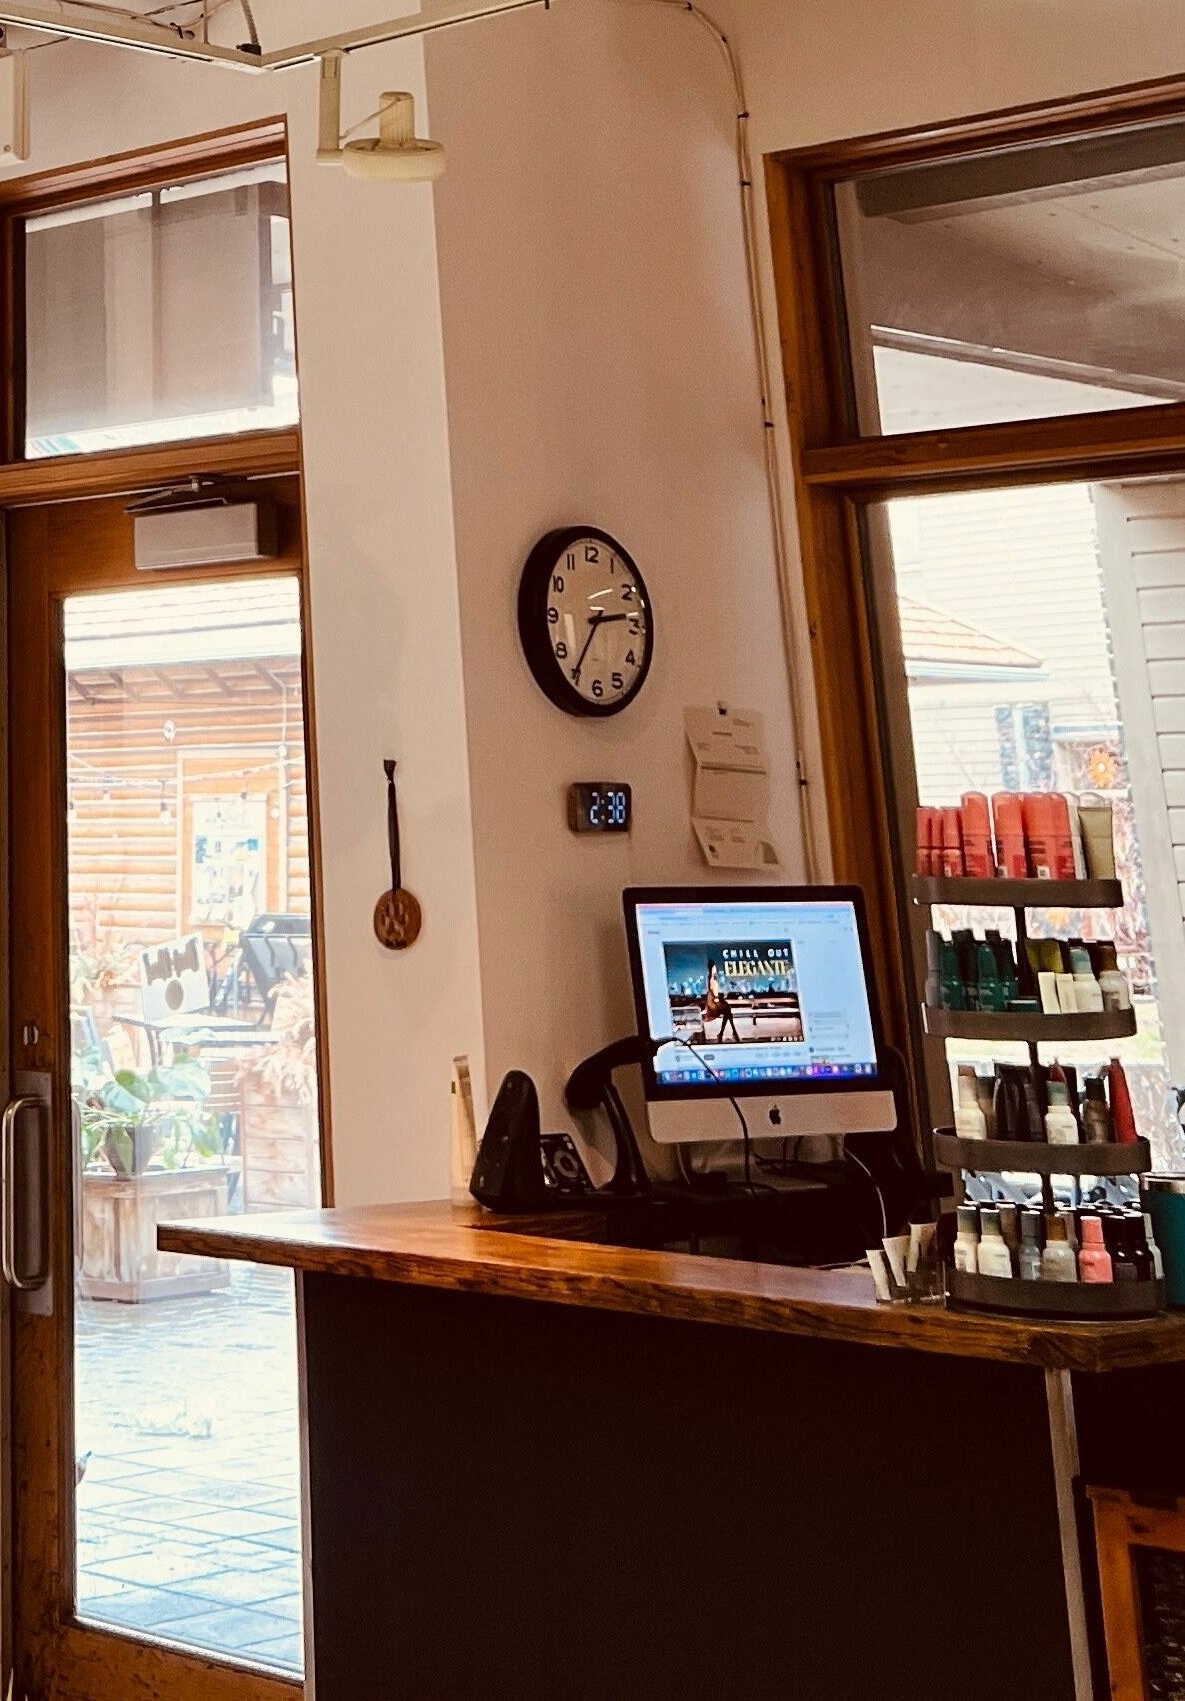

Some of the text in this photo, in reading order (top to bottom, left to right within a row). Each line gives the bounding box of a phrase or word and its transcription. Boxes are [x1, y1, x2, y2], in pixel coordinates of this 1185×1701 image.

[567, 554, 575, 570] 11
[585, 546, 599, 563] 12
[553, 576, 564, 592] 10
[621, 584, 632, 600] 2
[547, 608, 558, 623] 9
[556, 642, 567, 658] 8
[625, 650, 635, 665] 4
[592, 680, 603, 697] 6
[612, 673, 623, 689] 5
[722, 948, 789, 959] CHILL OUT
[724, 960, 789, 976] ELEGANTE
